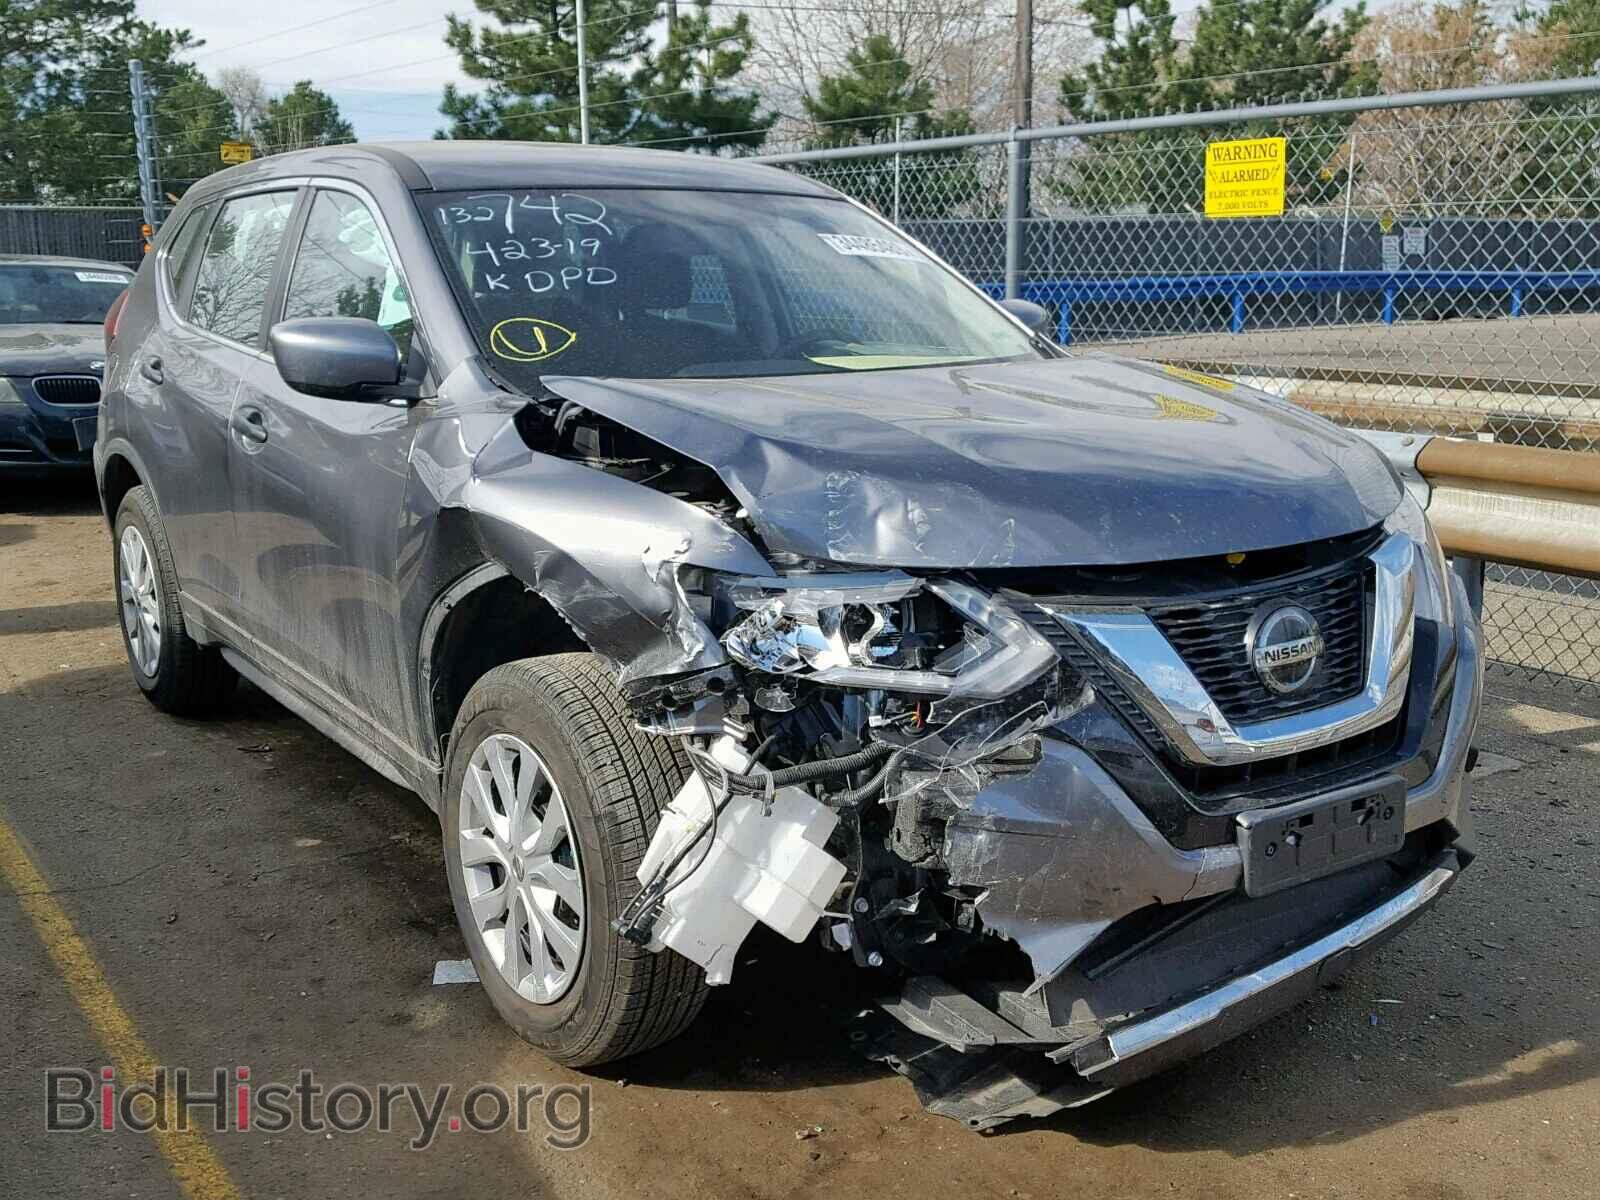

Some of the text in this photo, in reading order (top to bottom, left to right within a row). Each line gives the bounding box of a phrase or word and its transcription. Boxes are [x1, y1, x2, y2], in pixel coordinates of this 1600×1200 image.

[1212, 143, 1278, 161] WARNING
[1219, 168, 1270, 183] ALARMED
[1264, 639, 1316, 664] NISSAN
